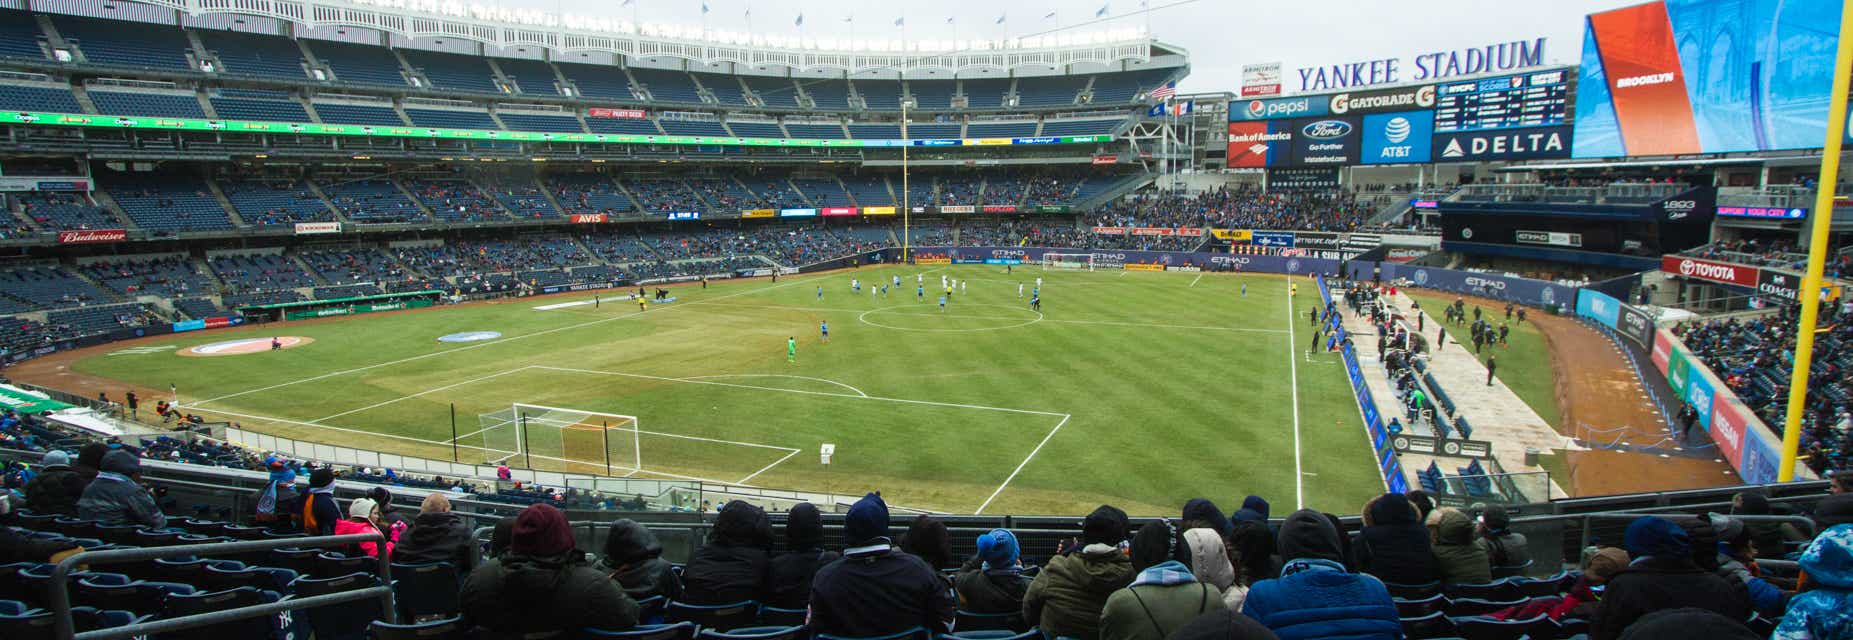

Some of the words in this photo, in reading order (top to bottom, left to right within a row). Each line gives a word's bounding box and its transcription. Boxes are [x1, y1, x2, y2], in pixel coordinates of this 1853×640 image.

[1298, 58, 1400, 92] YANKEE
[1413, 36, 1547, 81] STADIUM
[1616, 72, 1674, 89] BROOKLYN
[1267, 98, 1309, 116] pepsi
[1349, 93, 1414, 110] GATORADE
[1312, 121, 1342, 137] Ford
[1229, 134, 1249, 143] Bank
[1249, 132, 1259, 141] of
[1257, 131, 1292, 141] America
[1470, 132, 1563, 155] DELTA
[1308, 143, 1318, 151] Go
[1318, 142, 1344, 151] Further
[1381, 145, 1412, 158] AT&T
[1663, 200, 1696, 209] 1893
[578, 215, 601, 223] AVIS
[1767, 209, 1786, 217] CITY
[61, 231, 125, 243] Budweiser
[1210, 256, 1250, 264] ETIHAD
[1695, 268, 1736, 281] TOYOTA
[1464, 276, 1506, 290] ETIHAD
[1760, 282, 1797, 300] COACH
[1714, 409, 1740, 450] NISSAN
